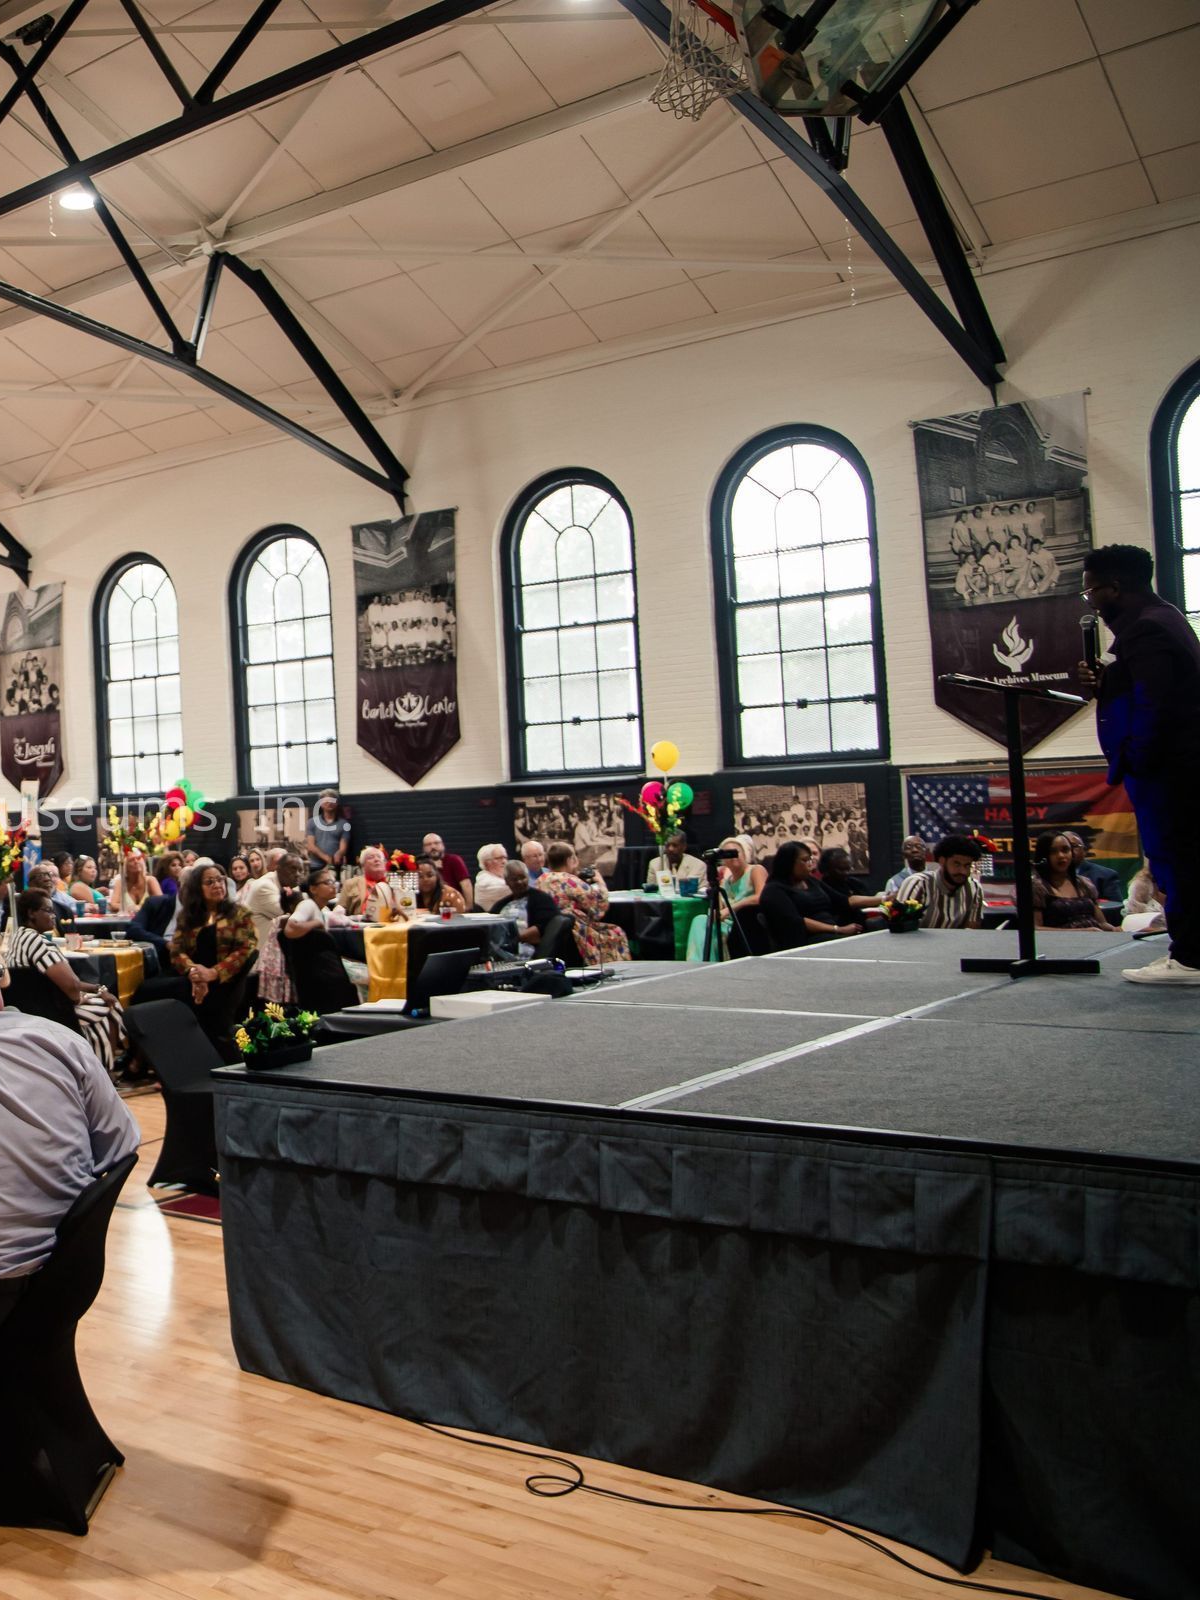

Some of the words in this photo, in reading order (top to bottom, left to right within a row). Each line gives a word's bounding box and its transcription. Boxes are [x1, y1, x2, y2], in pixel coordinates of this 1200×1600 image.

[1030, 672, 1068, 682] Museum
[24, 737, 55, 760] Joseph
[984, 806, 1048, 821] HAPY
